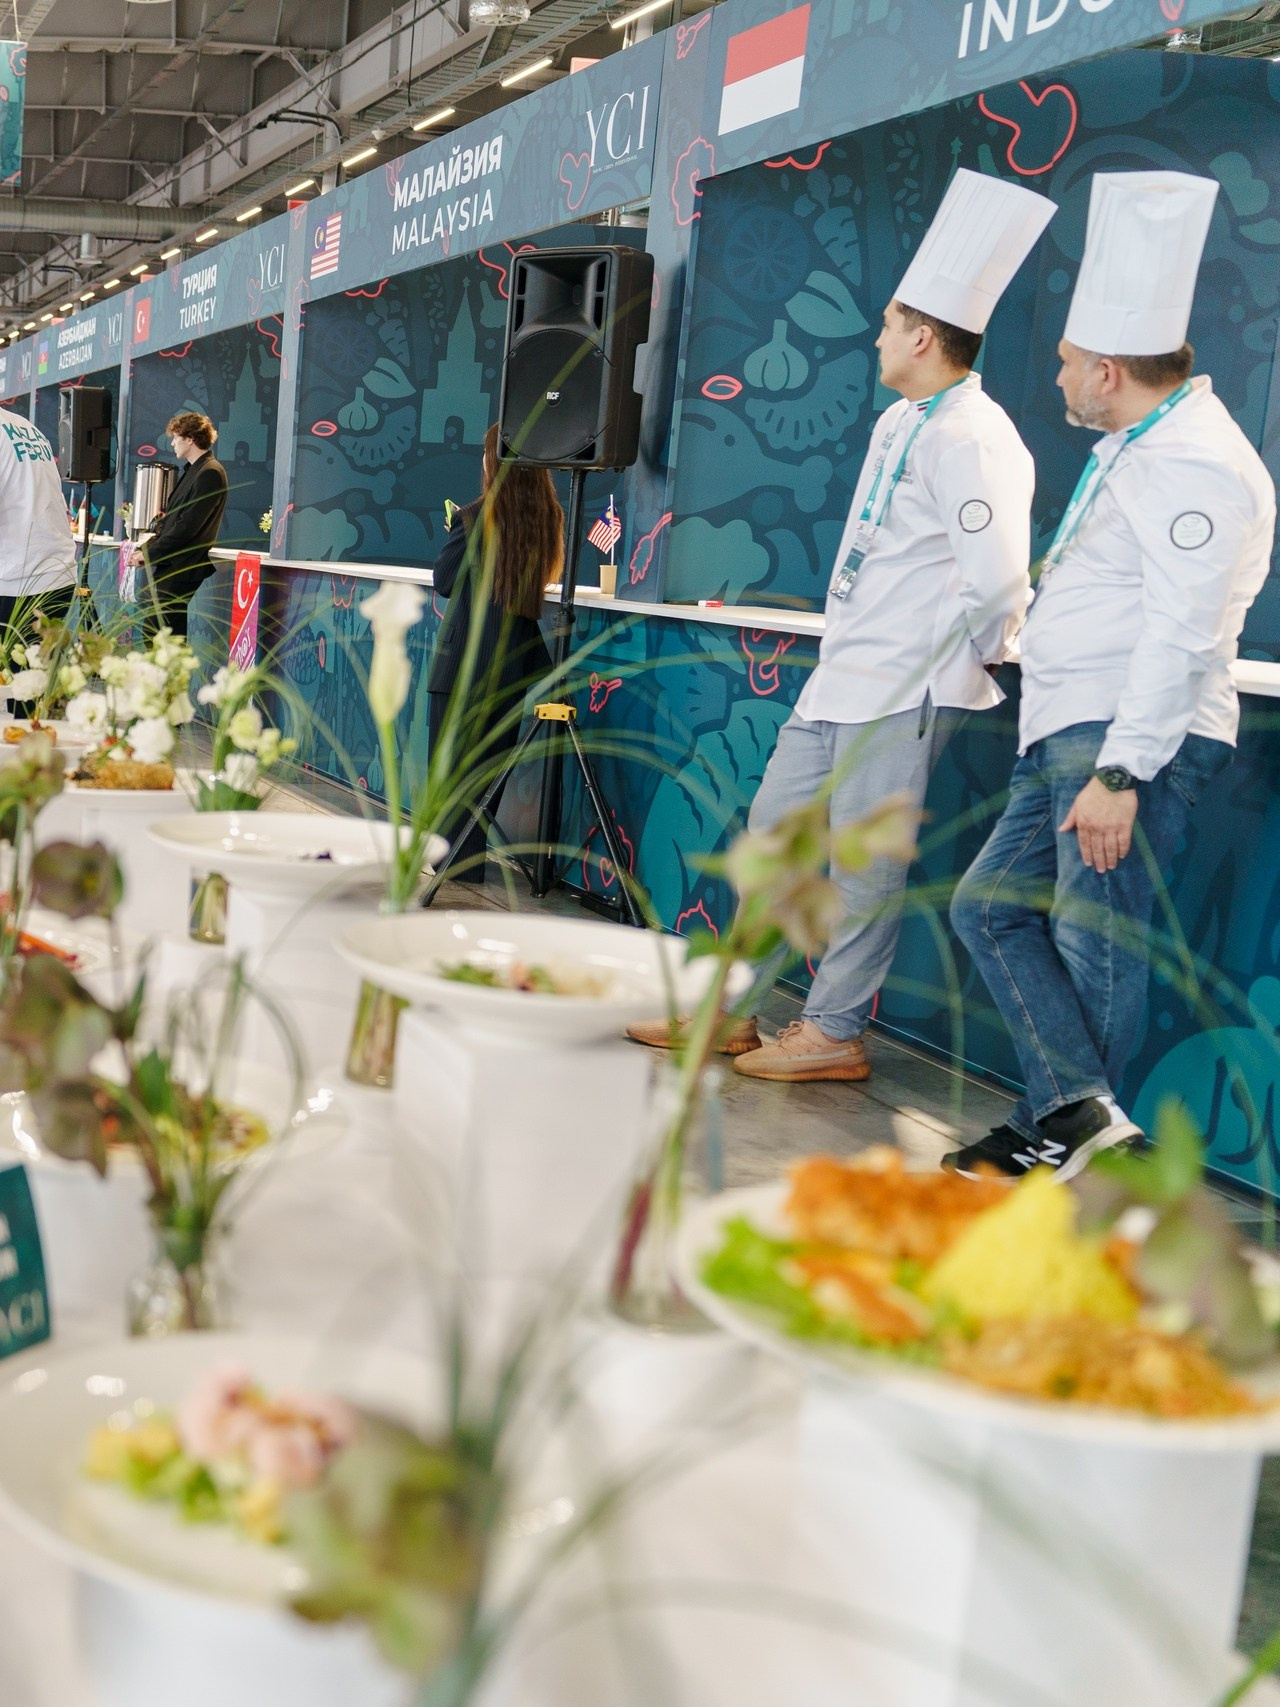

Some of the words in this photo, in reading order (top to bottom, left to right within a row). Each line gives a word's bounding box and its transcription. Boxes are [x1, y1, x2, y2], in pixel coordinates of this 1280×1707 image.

[958, 0, 1115, 59] IND
[586, 85, 651, 168] YCI
[393, 135, 503, 212] МАЛАЙЗИЯ
[392, 189, 494, 255] MALAYSIA
[182, 264, 218, 299] ТУРЦИЯ
[259, 244, 285, 290] YCI
[180, 296, 217, 330] TURKEY
[546, 391, 560, 400] RCF
[2, 423, 49, 442] KAZA
[13, 442, 52, 463] FORU
